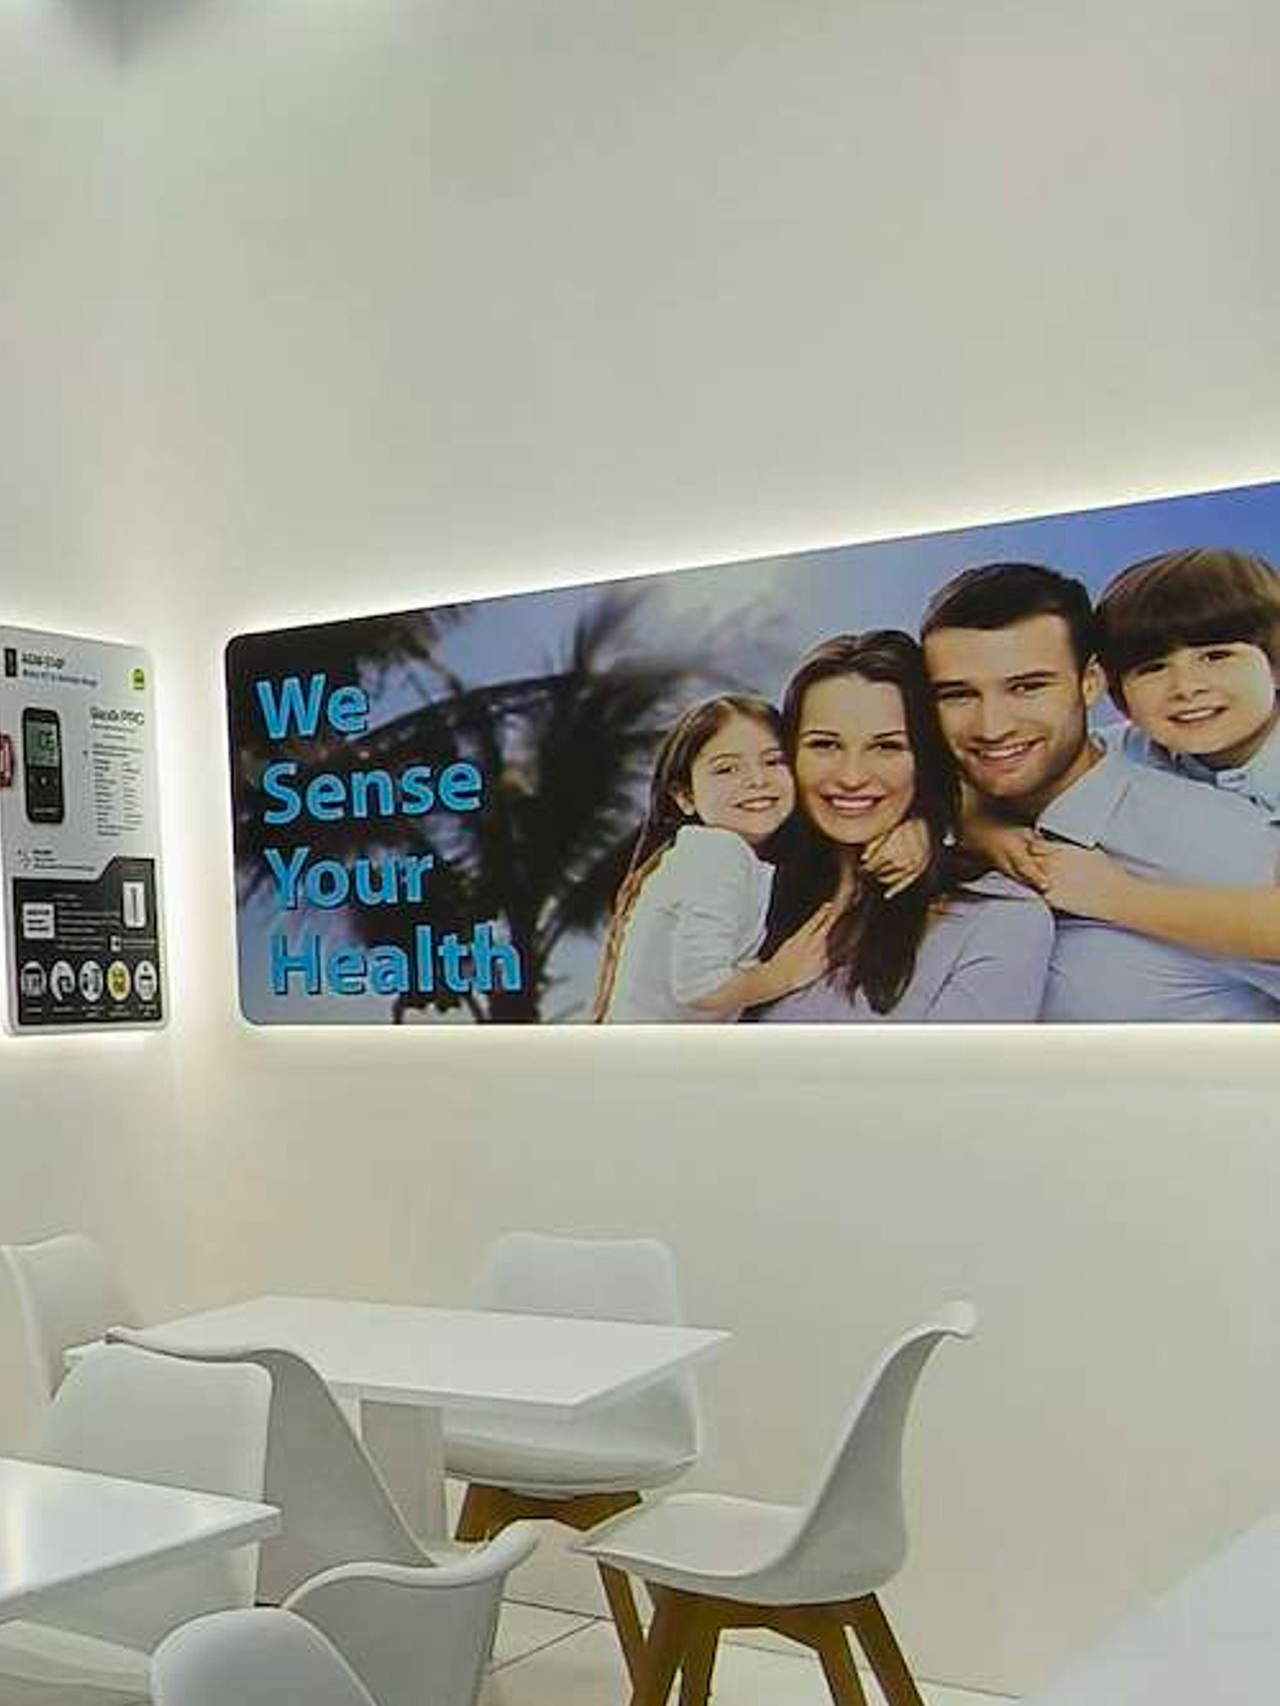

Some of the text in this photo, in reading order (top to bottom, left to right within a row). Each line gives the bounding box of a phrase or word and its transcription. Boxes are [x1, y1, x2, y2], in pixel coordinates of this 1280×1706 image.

[256, 672, 369, 740] We
[262, 759, 484, 826] Sense
[264, 846, 434, 910] Your
[270, 921, 522, 996] Health
